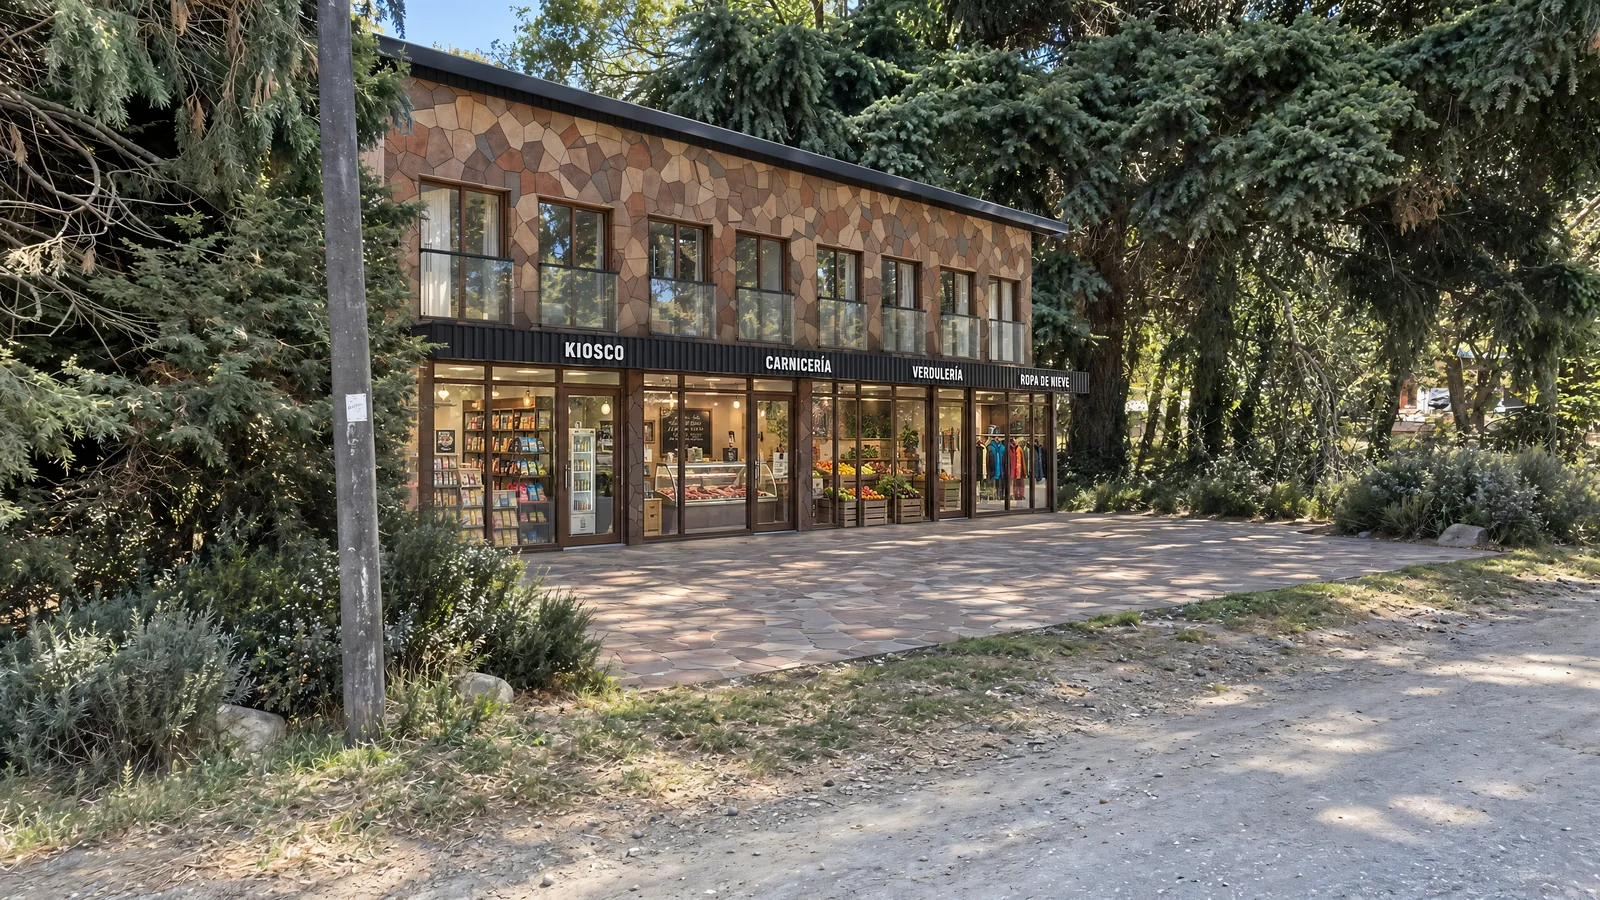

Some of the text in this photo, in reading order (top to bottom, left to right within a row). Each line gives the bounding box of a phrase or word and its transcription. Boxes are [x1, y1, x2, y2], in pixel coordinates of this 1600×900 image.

[565, 342, 624, 360] KIOSCO
[765, 355, 832, 373] CARNICERÍA
[912, 365, 963, 381] VERDULERÍA
[1020, 374, 1070, 388] ROPA DE NIEVE
